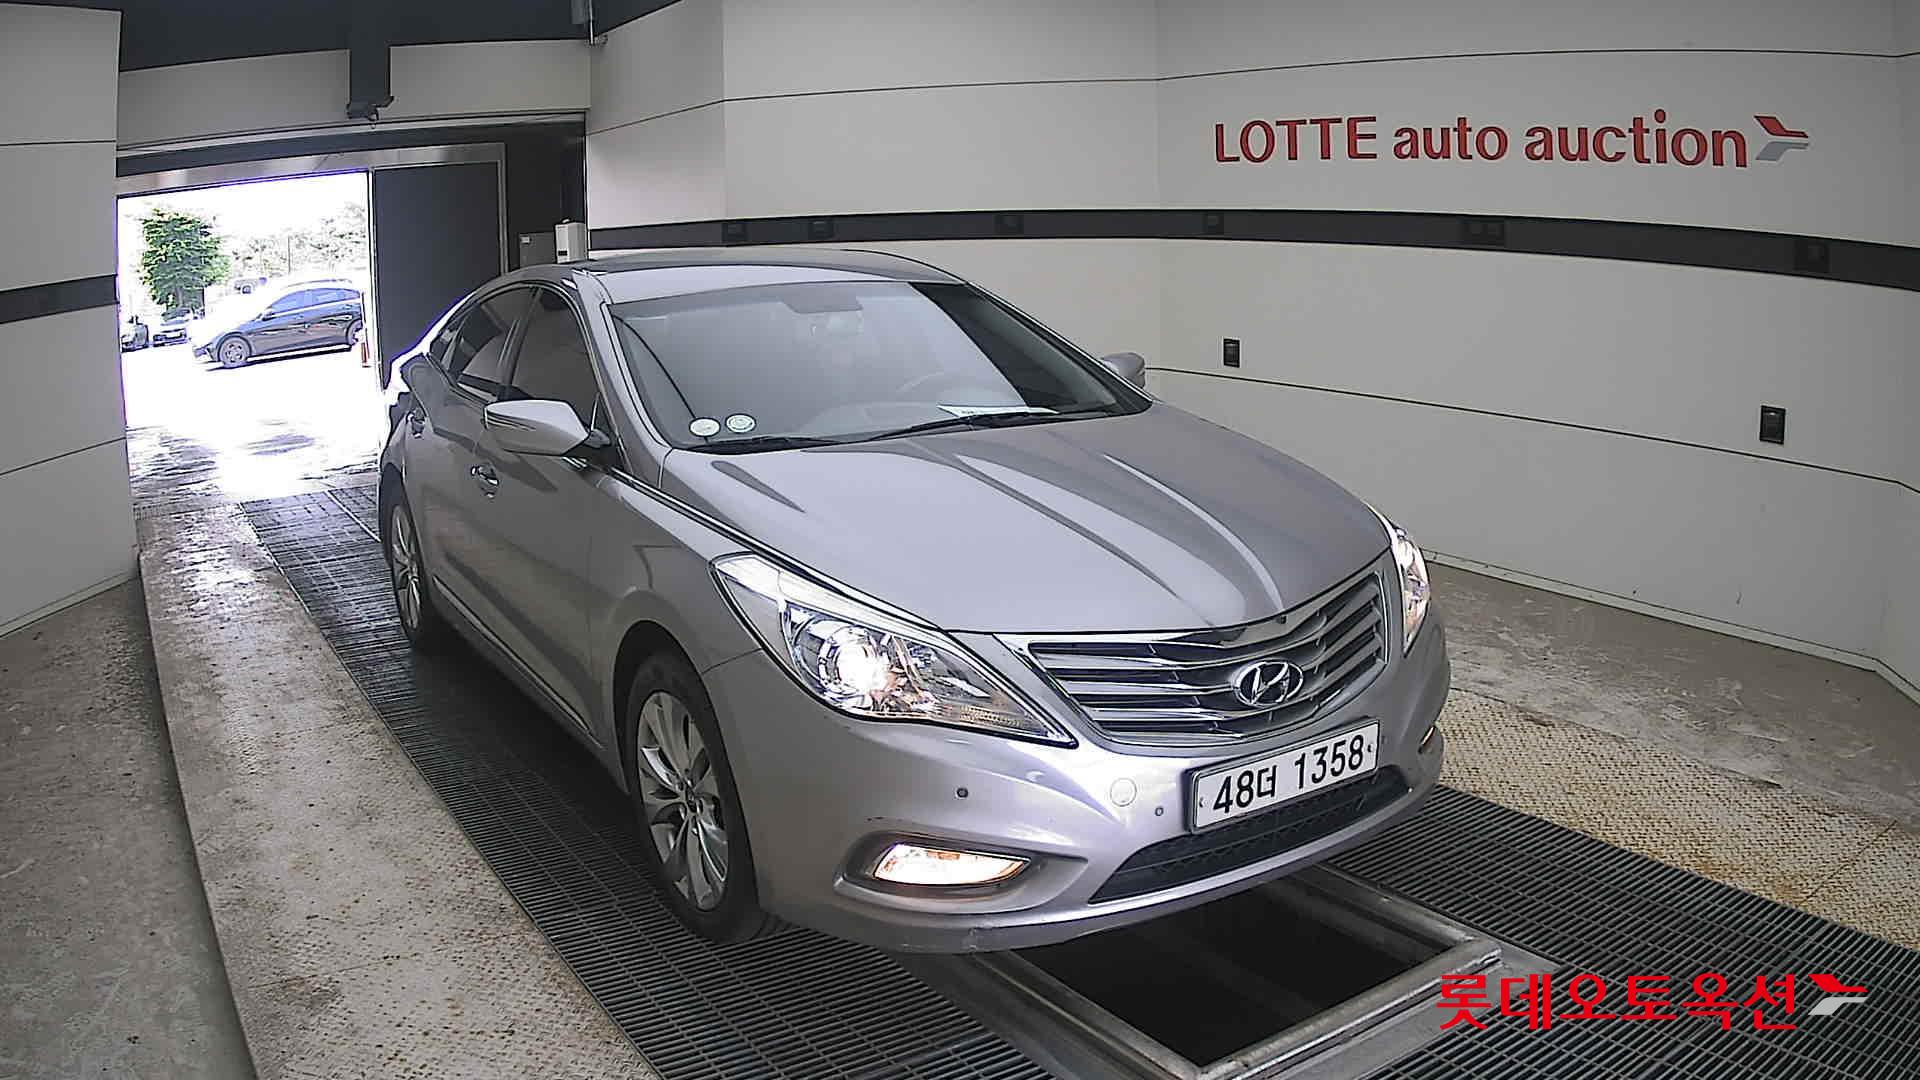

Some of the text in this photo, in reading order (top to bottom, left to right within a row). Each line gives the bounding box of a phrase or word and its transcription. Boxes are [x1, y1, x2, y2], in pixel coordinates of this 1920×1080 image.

[1215, 109, 1748, 167] LOTTE auto auction
[1212, 734, 1364, 814] 48더 1358
